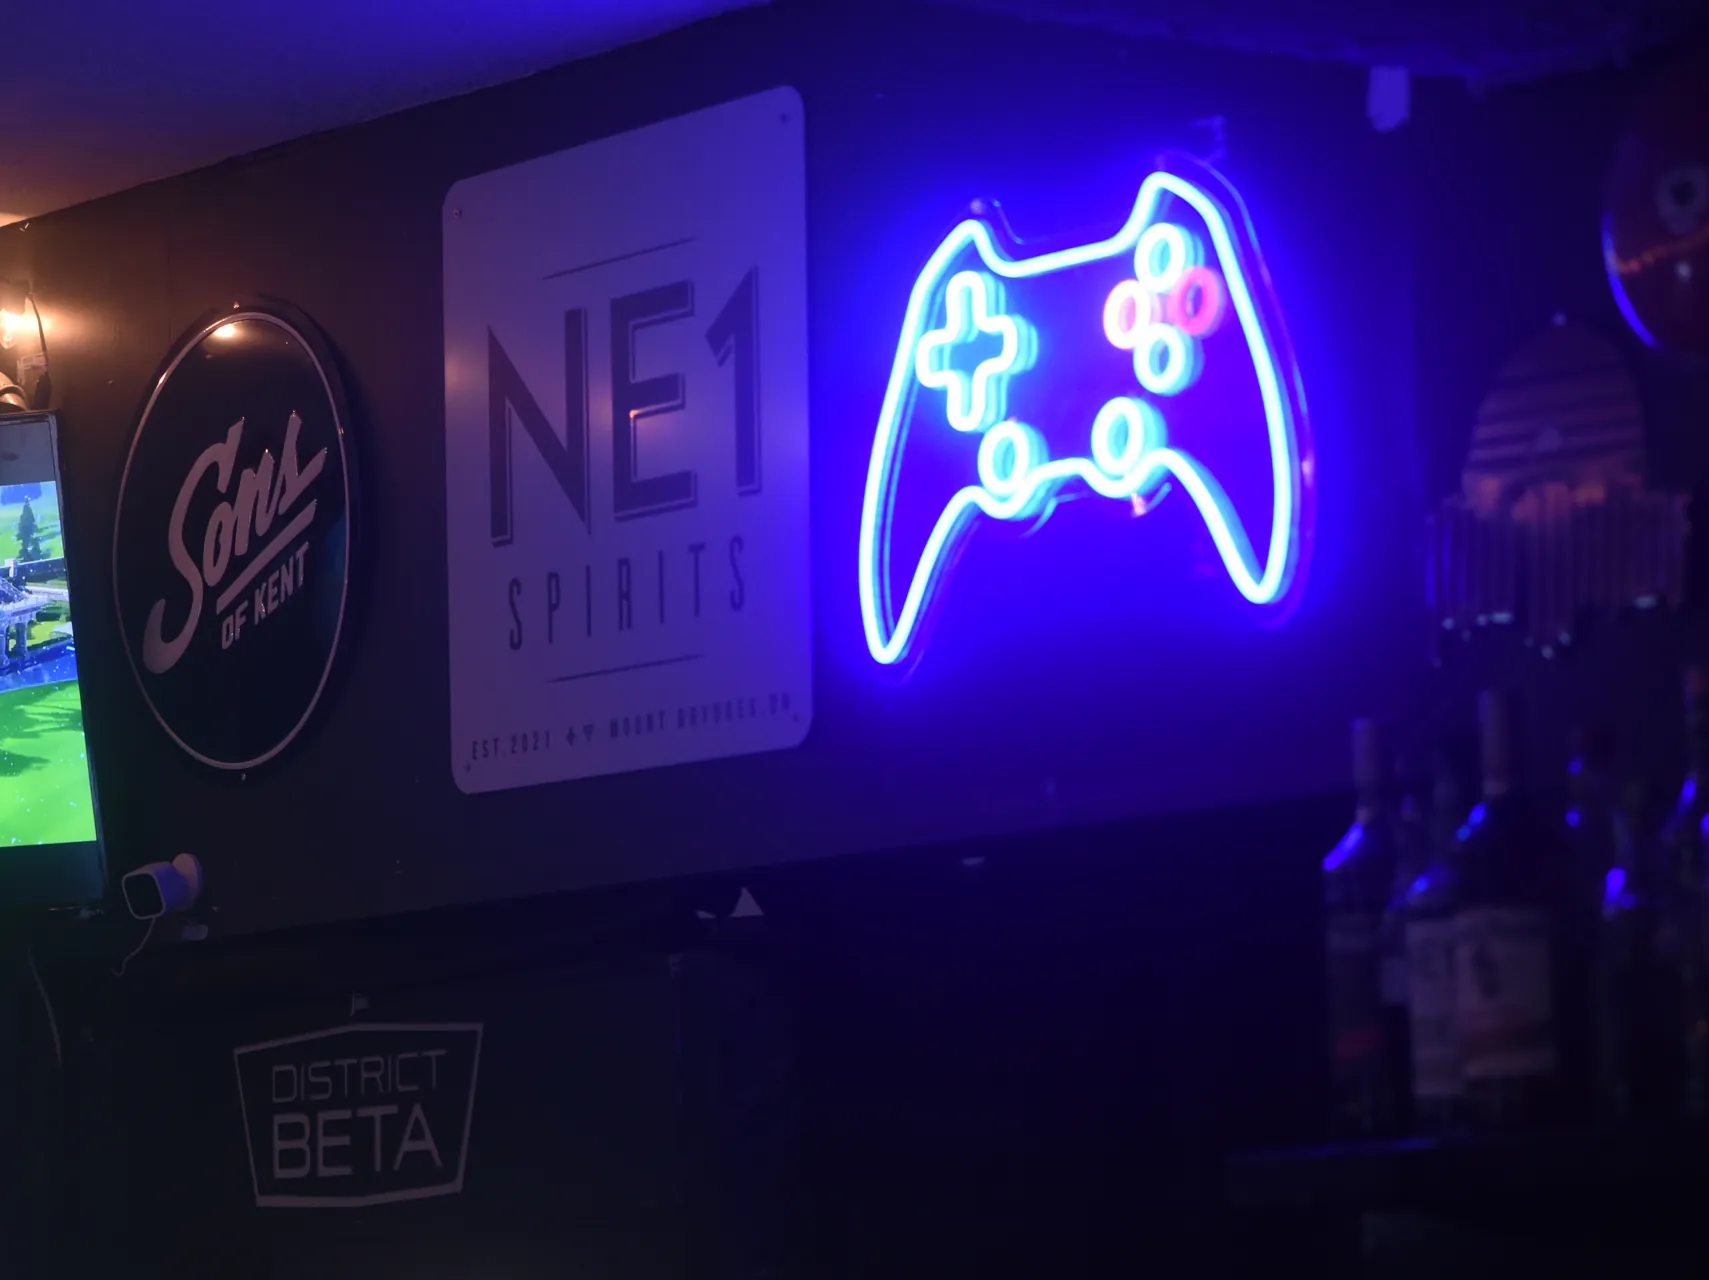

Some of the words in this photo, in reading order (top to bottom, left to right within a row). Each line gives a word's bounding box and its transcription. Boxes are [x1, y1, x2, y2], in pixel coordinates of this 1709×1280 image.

[487, 263, 763, 548] NE1
[143, 411, 328, 674] Sons
[221, 601, 249, 650] OF
[254, 541, 309, 625] KENT
[507, 535, 746, 652] SPIRITS
[272, 1049, 447, 1103] DISTRICT
[273, 1103, 443, 1179] BETA
